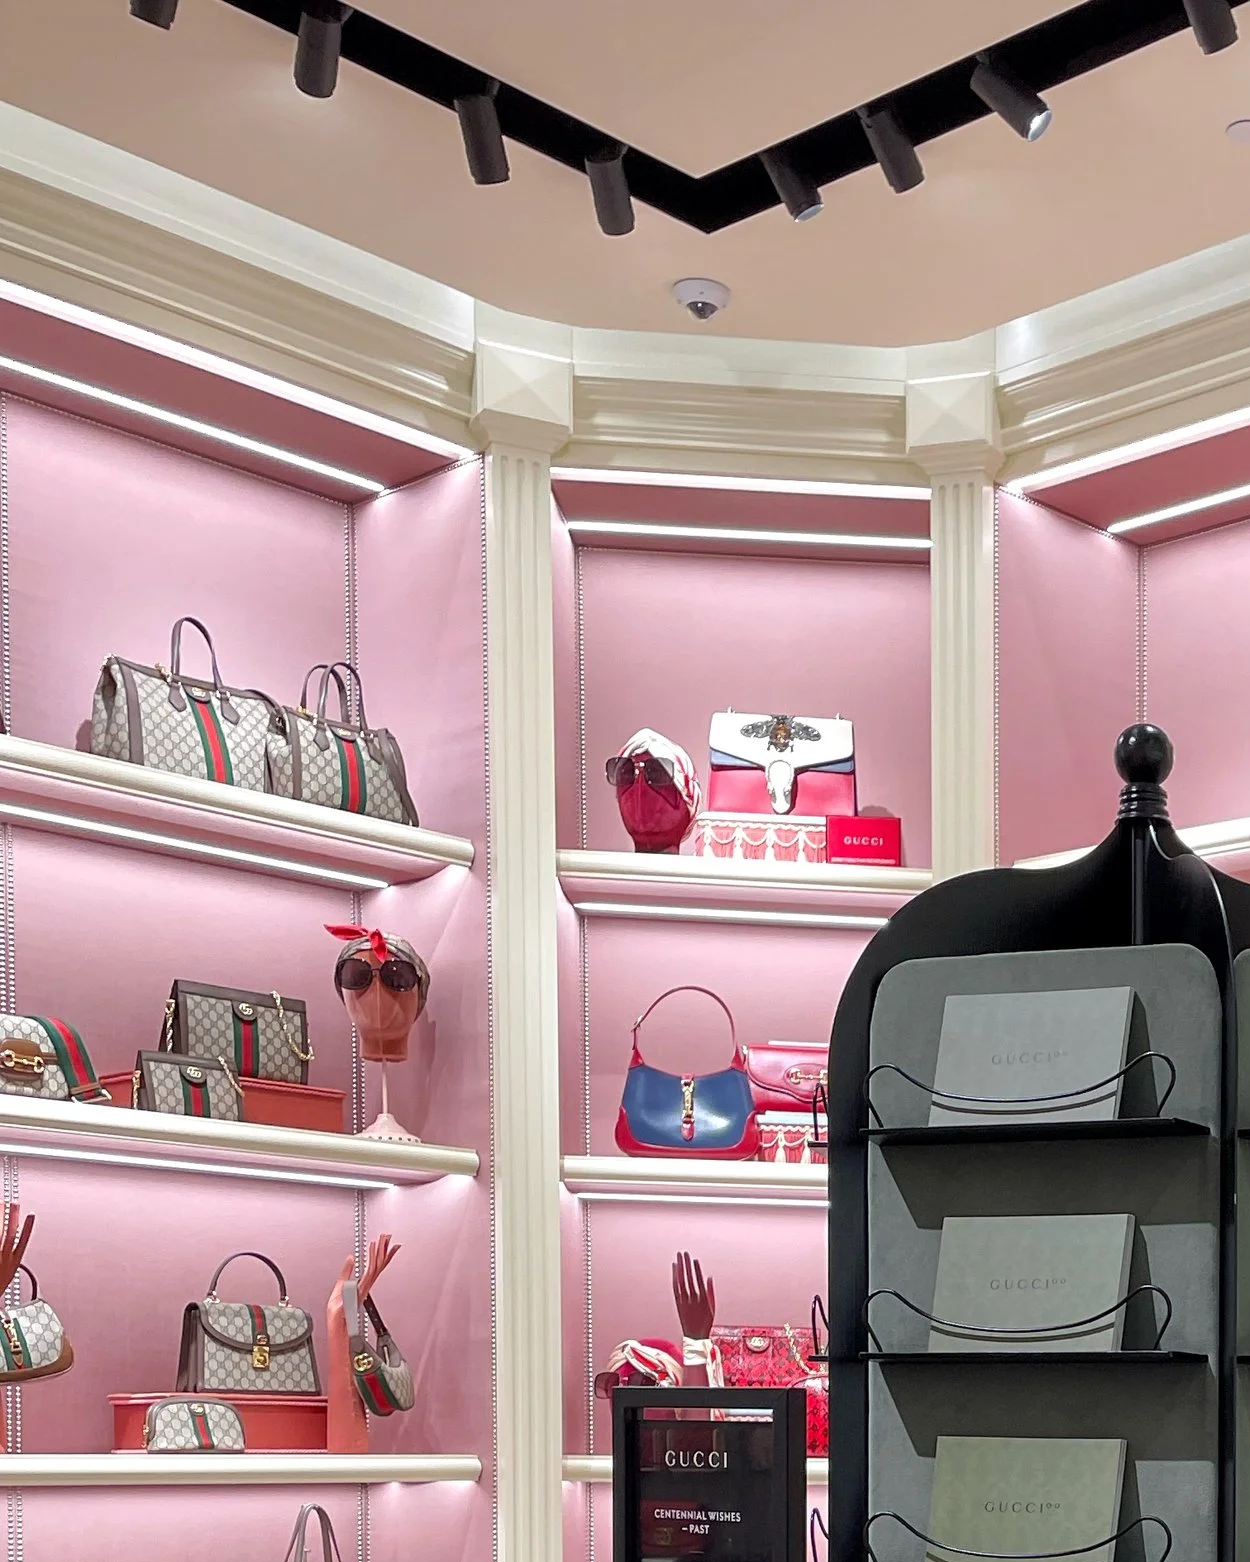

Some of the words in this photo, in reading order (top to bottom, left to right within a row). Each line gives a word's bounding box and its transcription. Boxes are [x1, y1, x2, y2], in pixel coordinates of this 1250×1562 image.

[843, 835, 884, 846] GUCCI
[665, 1450, 728, 1469] GUCCI
[654, 1508, 707, 1520] CENTENNIAL
[708, 1511, 741, 1522] WISHES
[689, 1524, 710, 1534] PAST
